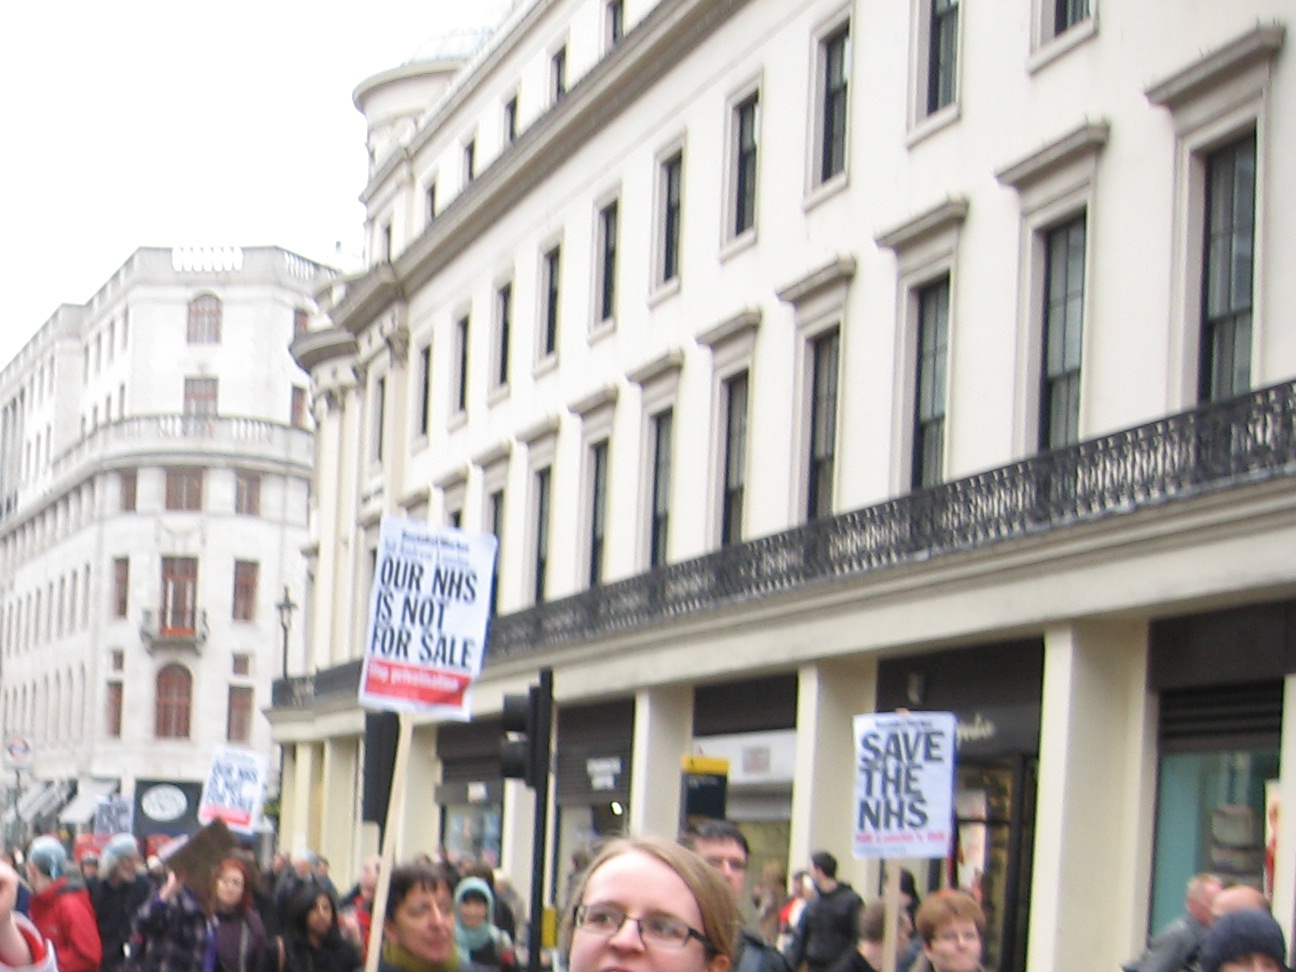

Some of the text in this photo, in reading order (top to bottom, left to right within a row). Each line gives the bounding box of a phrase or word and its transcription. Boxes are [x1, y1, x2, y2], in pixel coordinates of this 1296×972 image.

[380, 555, 478, 603] OUR NHS
[375, 589, 449, 630] IS NOT
[371, 623, 474, 667] FOR SALE
[860, 731, 945, 763] SAVE
[858, 764, 923, 797] THE
[858, 799, 929, 830] NHS
